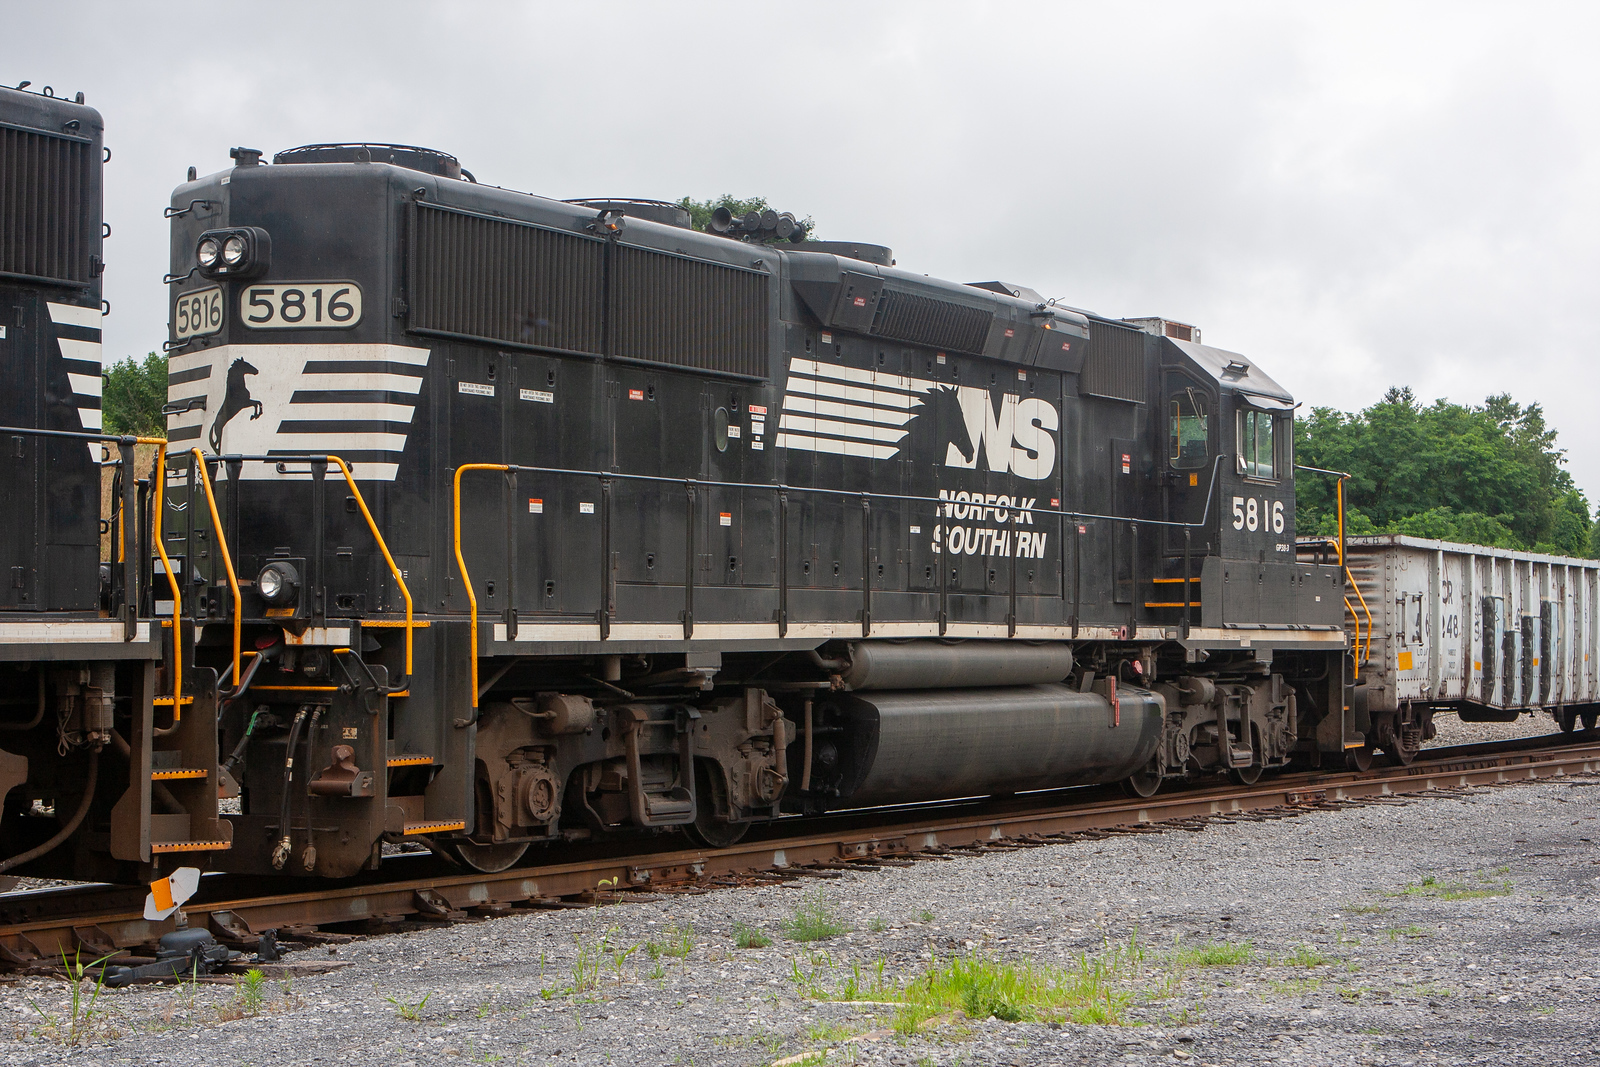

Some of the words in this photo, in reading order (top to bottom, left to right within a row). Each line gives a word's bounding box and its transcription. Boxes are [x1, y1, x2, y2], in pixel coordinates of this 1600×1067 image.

[178, 292, 221, 333] 5816
[248, 288, 354, 323] 5816
[945, 385, 1059, 480] NS
[936, 489, 1036, 525] NORFOLK
[1232, 496, 1285, 534] 5816
